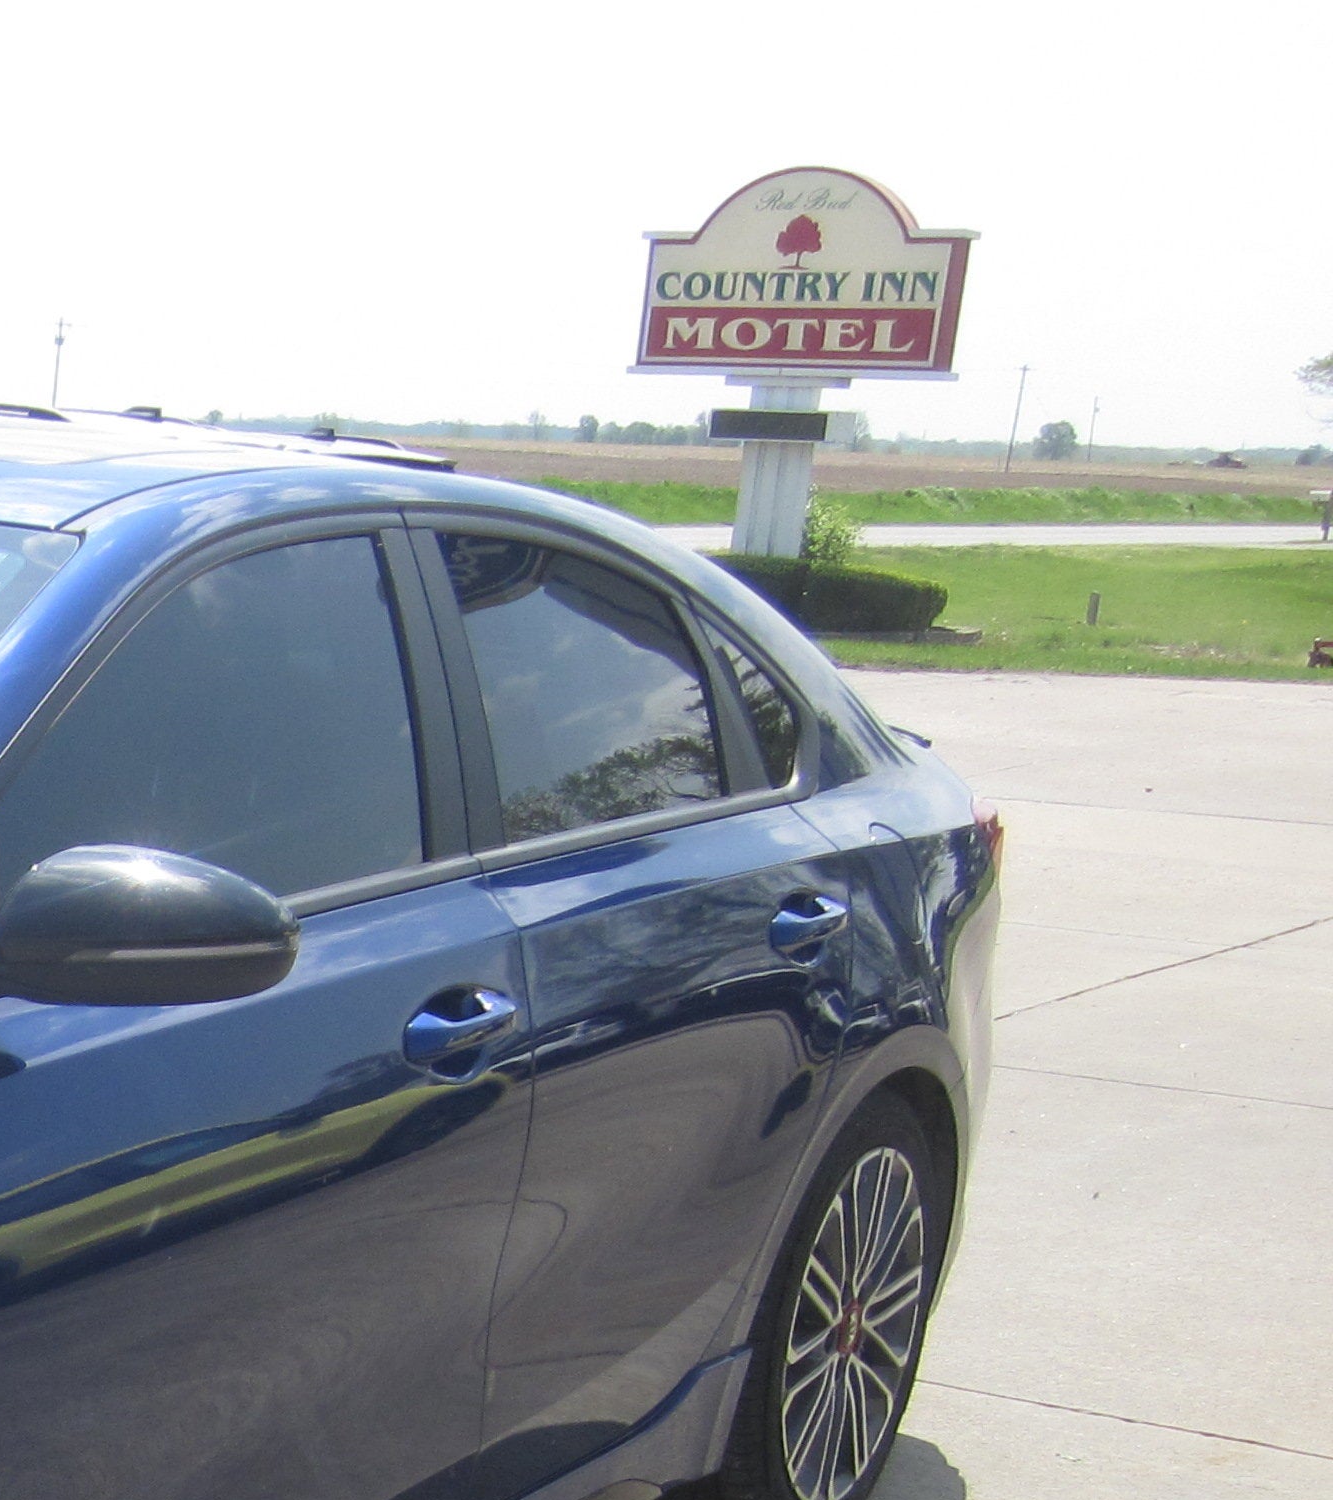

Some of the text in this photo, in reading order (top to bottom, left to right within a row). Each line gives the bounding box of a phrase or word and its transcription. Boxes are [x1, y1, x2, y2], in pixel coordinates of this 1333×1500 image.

[655, 270, 940, 303] COUNTRY INN
[662, 316, 916, 353] MOTEL
